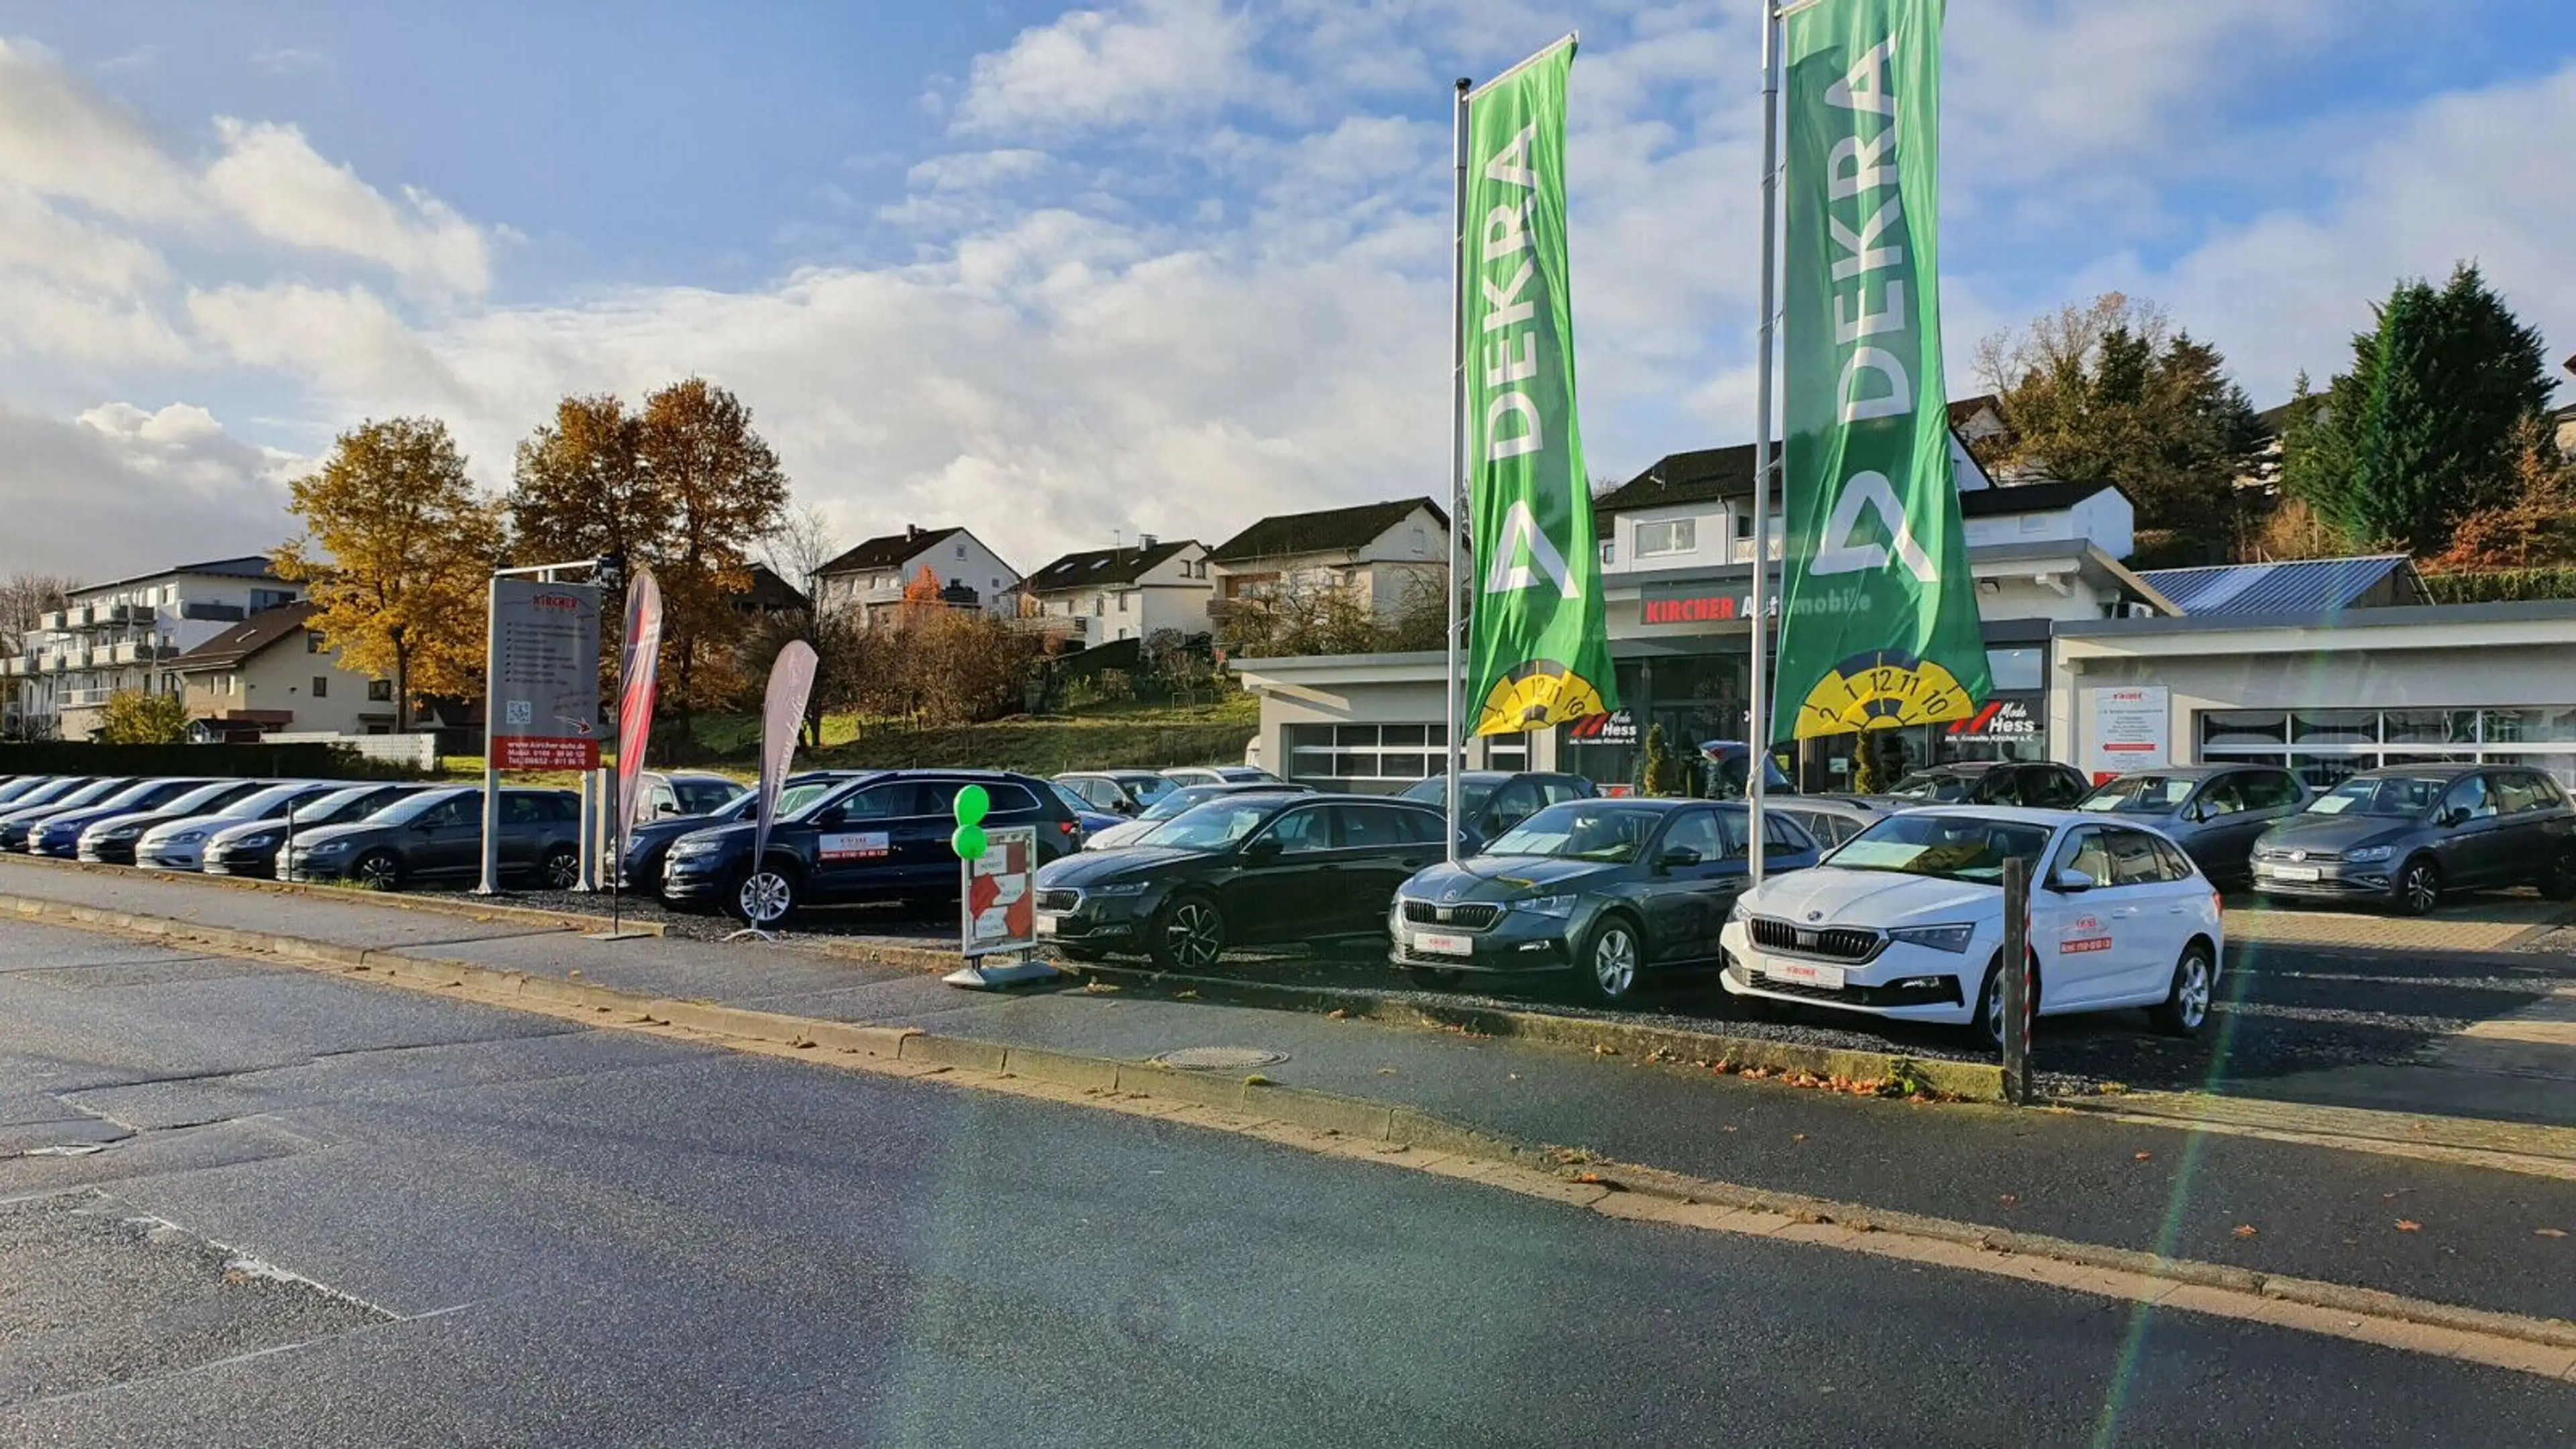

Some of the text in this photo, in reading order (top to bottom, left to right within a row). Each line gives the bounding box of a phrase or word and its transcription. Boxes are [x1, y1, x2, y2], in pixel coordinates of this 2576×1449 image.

[1824, 30, 1913, 426] DEKRA
[1483, 121, 1543, 462] DEKRA
[532, 595, 577, 608] KIRCHER
[1646, 587, 1872, 623] KIRCHER Atmobile
[1532, 678, 1545, 698] 12
[1819, 669, 1949, 722] 2 1 12 11 10
[1601, 722, 1637, 736] Hess
[1988, 717, 2035, 733] Hess
